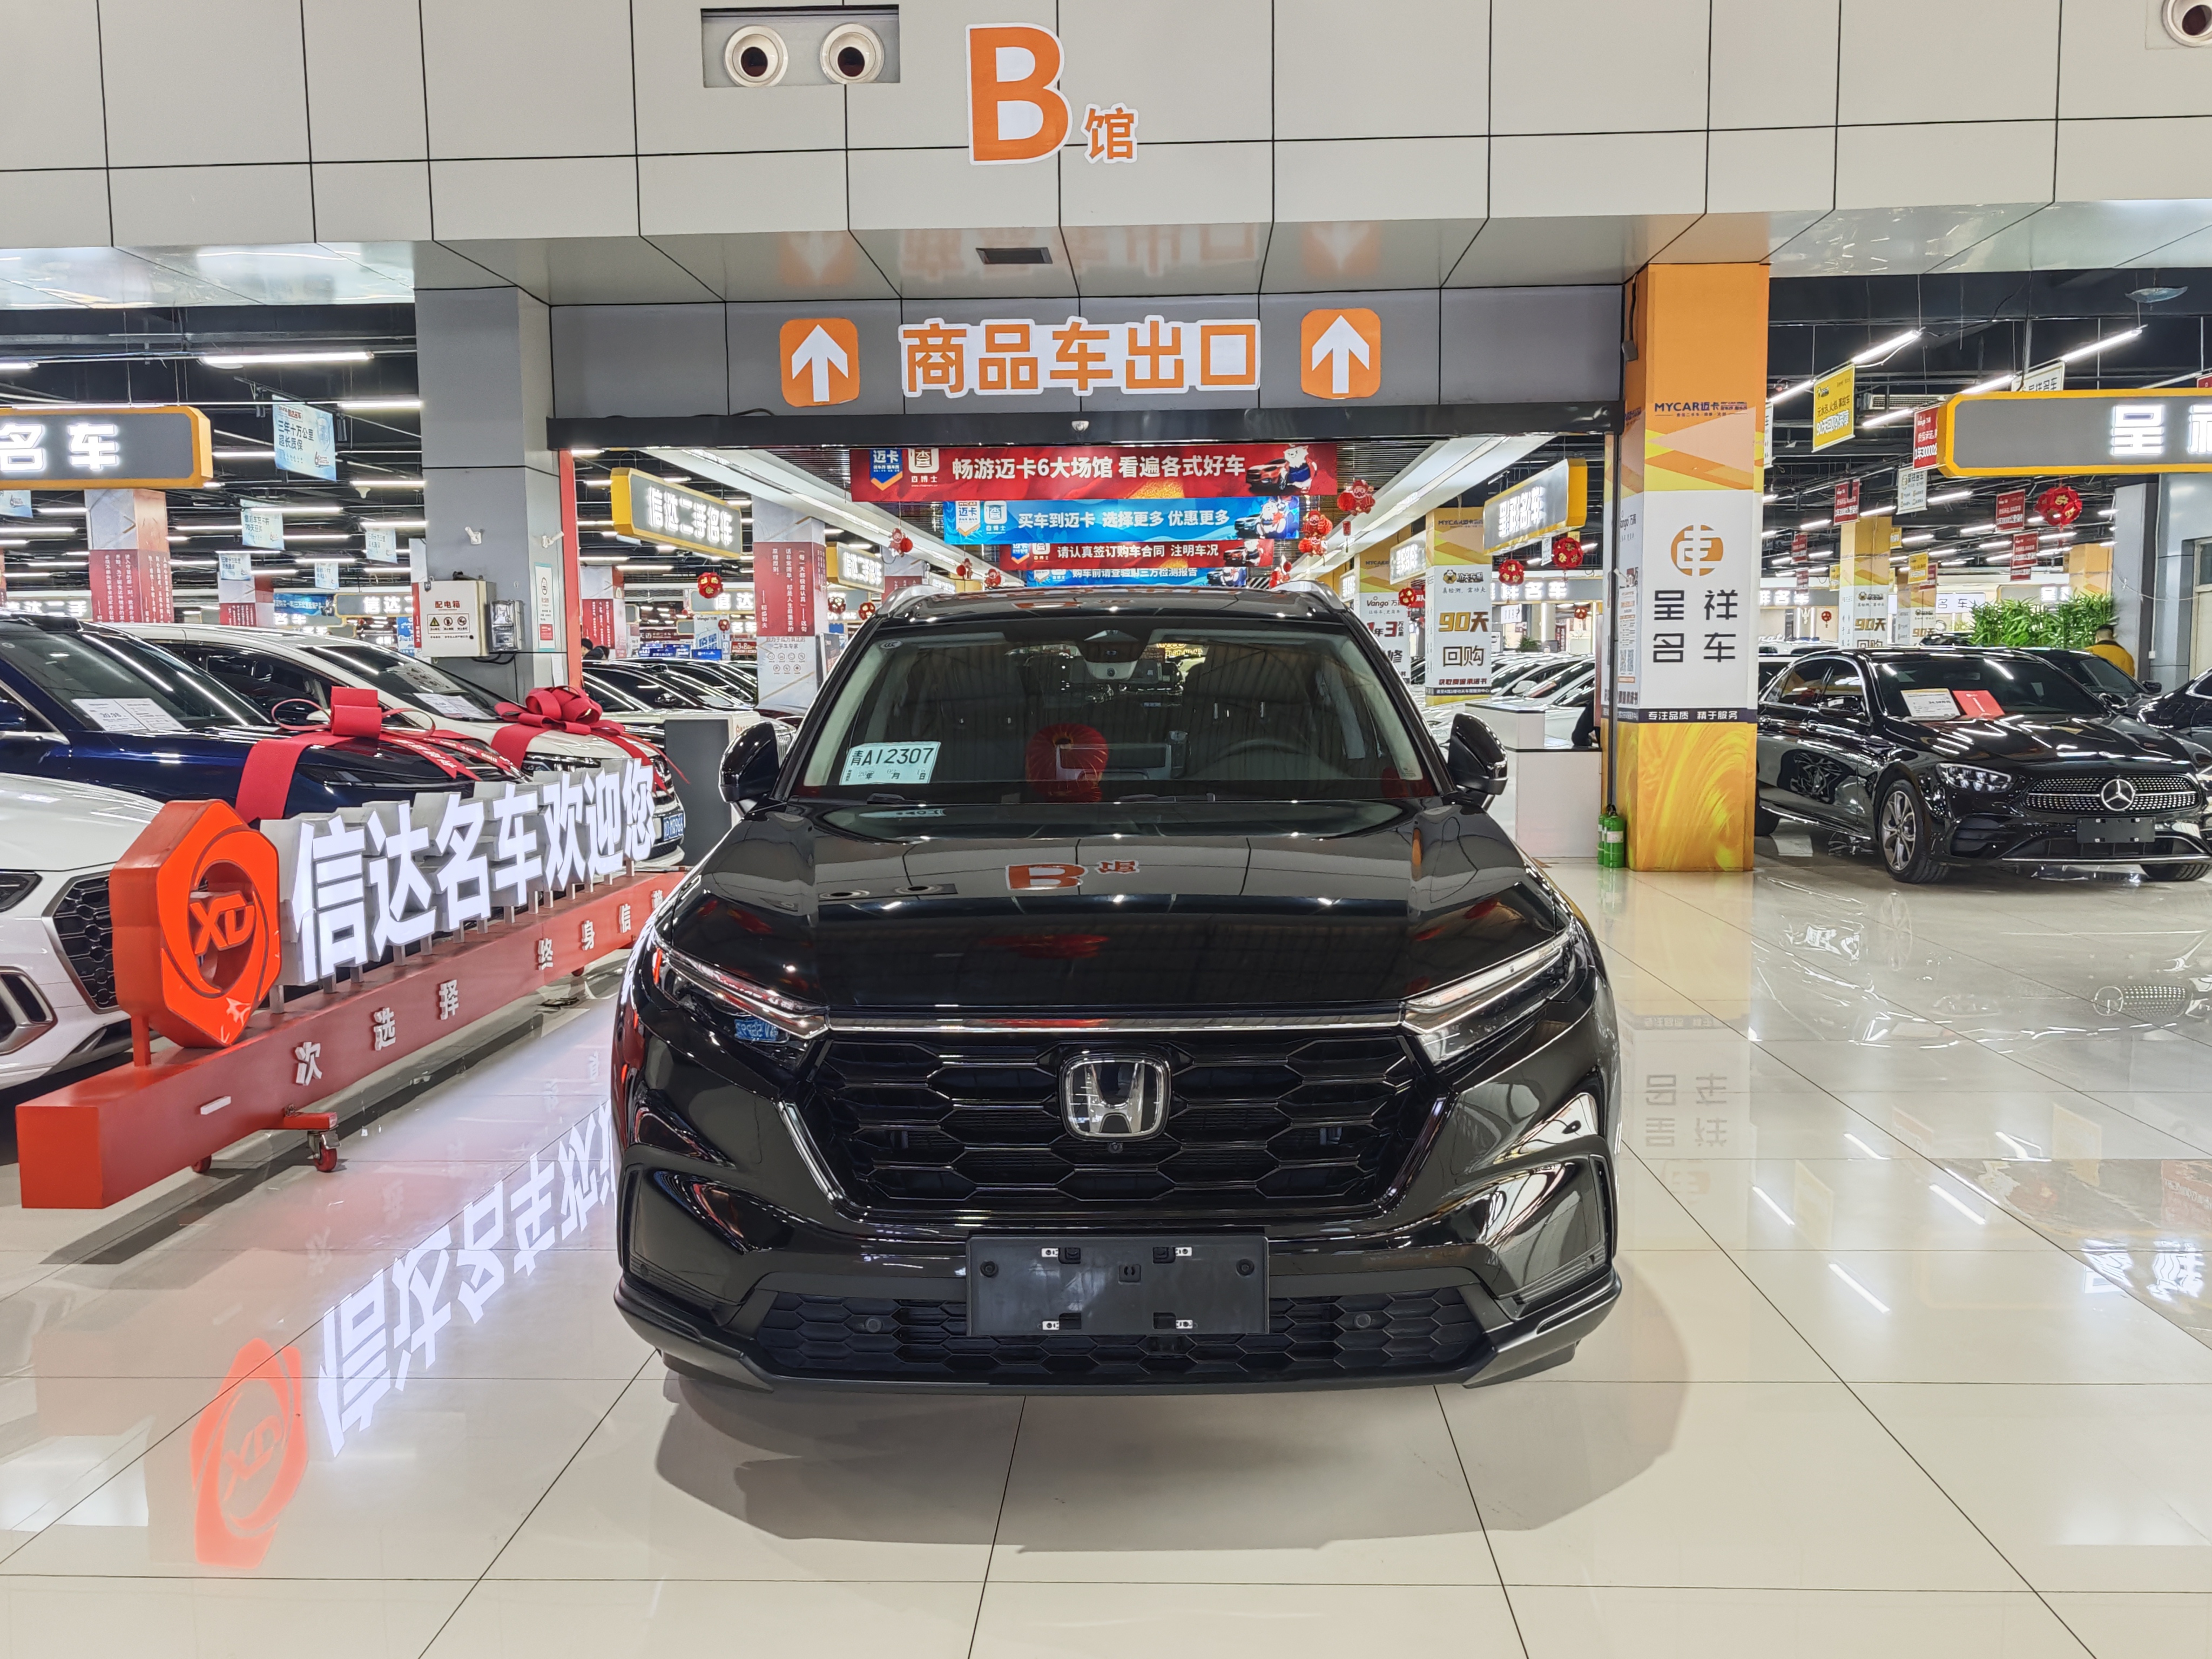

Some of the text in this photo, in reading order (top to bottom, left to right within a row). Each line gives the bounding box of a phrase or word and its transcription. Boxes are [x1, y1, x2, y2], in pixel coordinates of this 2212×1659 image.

[968, 25, 1136, 163] B 馆
[902, 320, 1257, 393] 商品车出口
[0, 424, 119, 471] 名车
[873, 450, 899, 463] 迈卡
[952, 455, 1245, 479] 畅游迈卡6大场馆 看遍各式好车
[647, 485, 733, 546] 信达二手名车
[959, 507, 977, 516] 迈卡
[1019, 509, 1230, 529] 买车到迈卡 选择更多 优惠更多
[1499, 487, 1545, 537] 呈祥名车
[1057, 544, 1219, 558] 请认真签订购车合同 注明车况
[435, 601, 460, 609] 配电箱
[714, 593, 754, 610] 信达
[1367, 599, 1389, 608] Vango
[1654, 589, 1738, 621] 呈祥
[1438, 611, 1490, 632] 90天
[1854, 618, 1886, 631] 90天
[1442, 646, 1484, 667] 回购
[1653, 632, 1737, 663] 名车
[1648, 711, 1738, 720] 专注品质 精于服务
[292, 758, 655, 982] 信达名车欢迎您
[189, 893, 255, 955] XD
